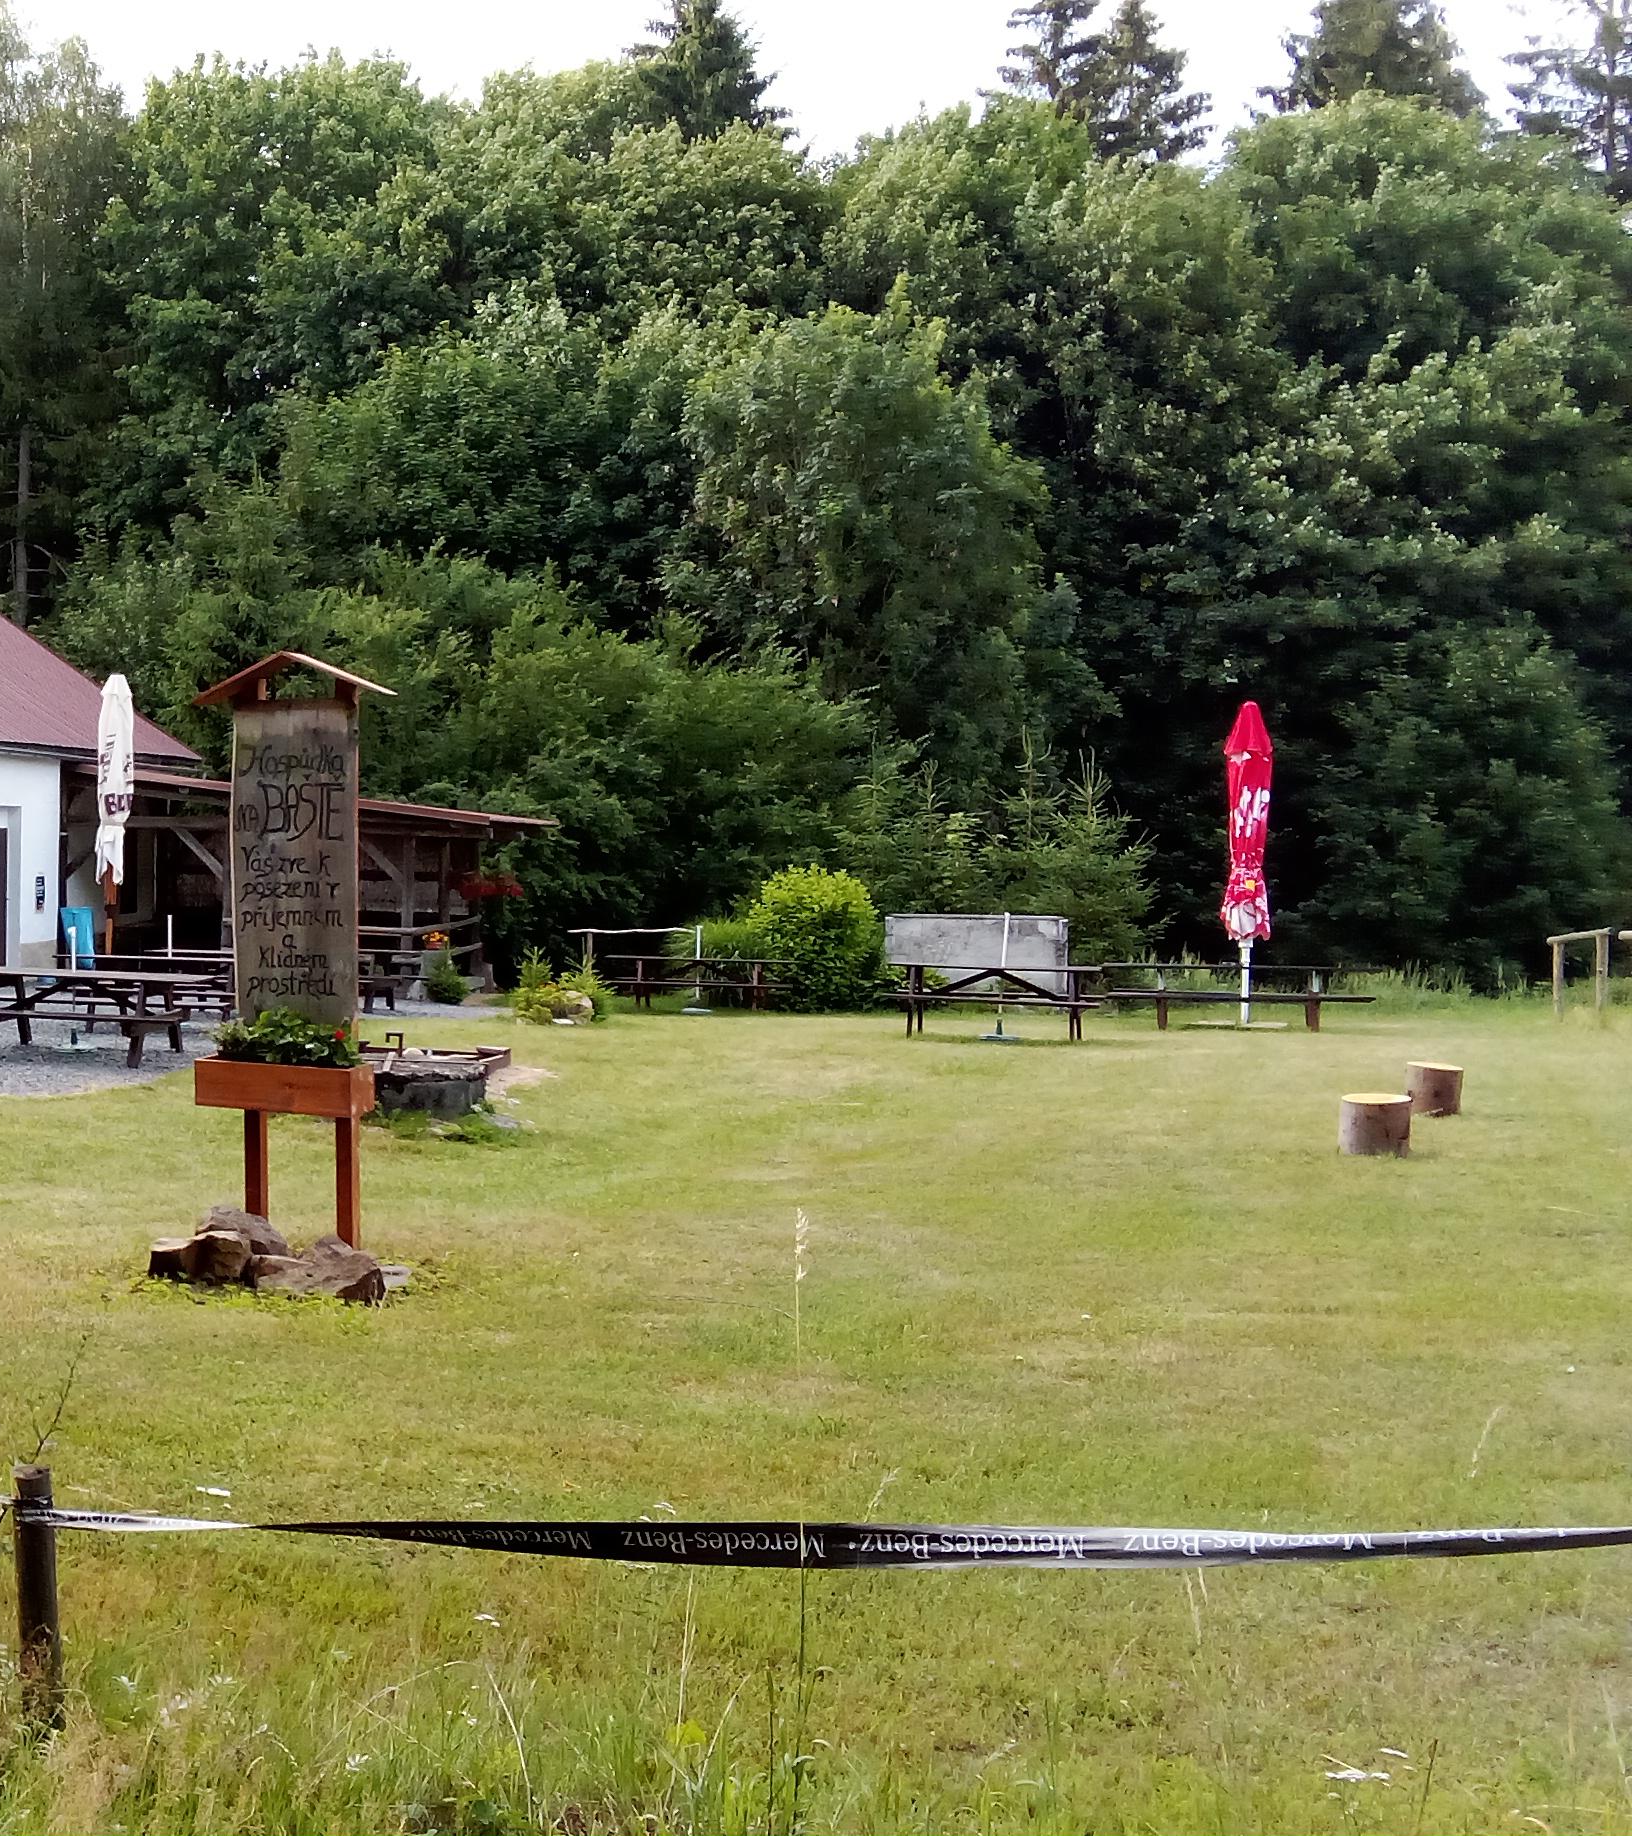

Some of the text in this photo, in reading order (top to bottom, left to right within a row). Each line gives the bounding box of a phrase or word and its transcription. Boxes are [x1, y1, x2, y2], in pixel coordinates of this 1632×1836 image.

[282, 934, 297, 949] a
[409, 1528, 592, 1550] Mercedes-Benz
[620, 1530, 827, 1558] Mercedes-Benz
[859, 1532, 1086, 1560] Mercedes-Benz
